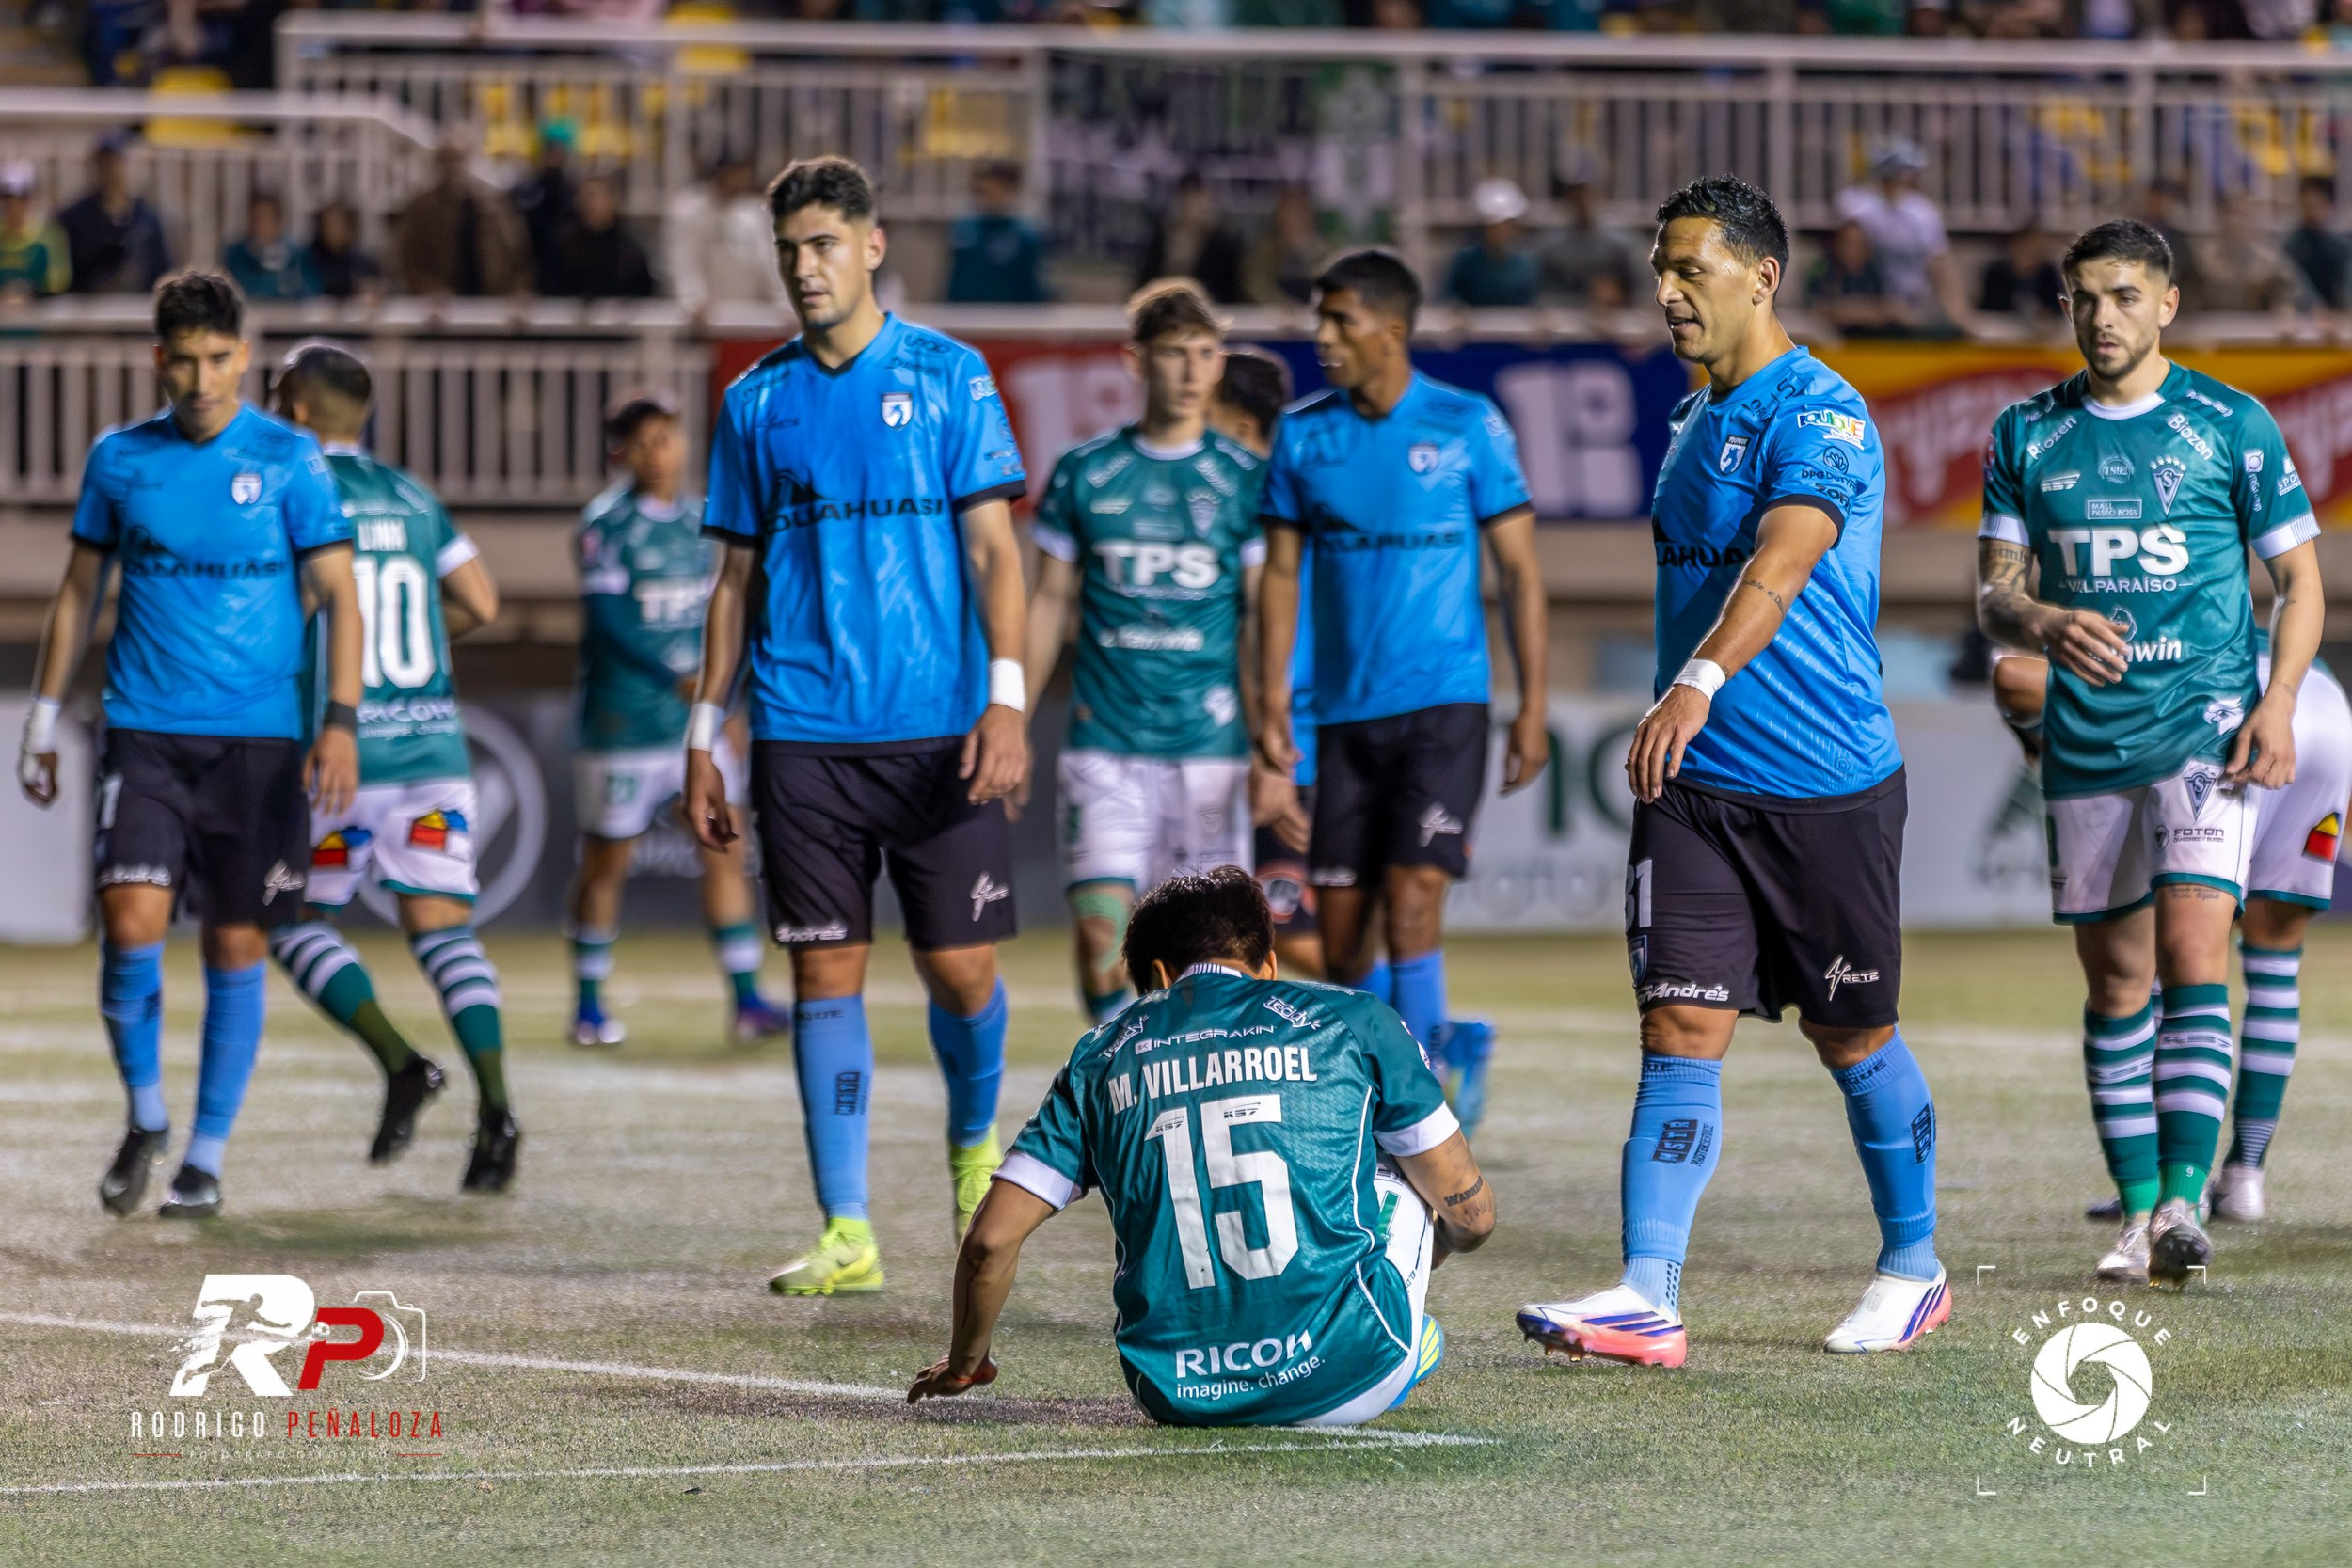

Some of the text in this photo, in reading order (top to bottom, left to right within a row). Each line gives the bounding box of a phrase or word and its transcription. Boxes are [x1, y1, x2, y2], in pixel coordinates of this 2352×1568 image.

[2168, 413, 2213, 461] Biozen
[1091, 539, 1221, 589] TPS
[2047, 523, 2189, 577] TPS
[2067, 577, 2177, 594] VALPARAÍSO
[354, 554, 437, 688] 10
[2173, 828, 2224, 836] FOTON
[1153, 1025, 1275, 1048] INTEGRAKIN
[1263, 996, 1311, 1029] Teddy
[1108, 1046, 1316, 1115] M. VILLARROEL
[1145, 1094, 1299, 1290] 15
[1176, 1329, 1313, 1379] RICOH
[1177, 1359, 1326, 1401] imagine. change.
